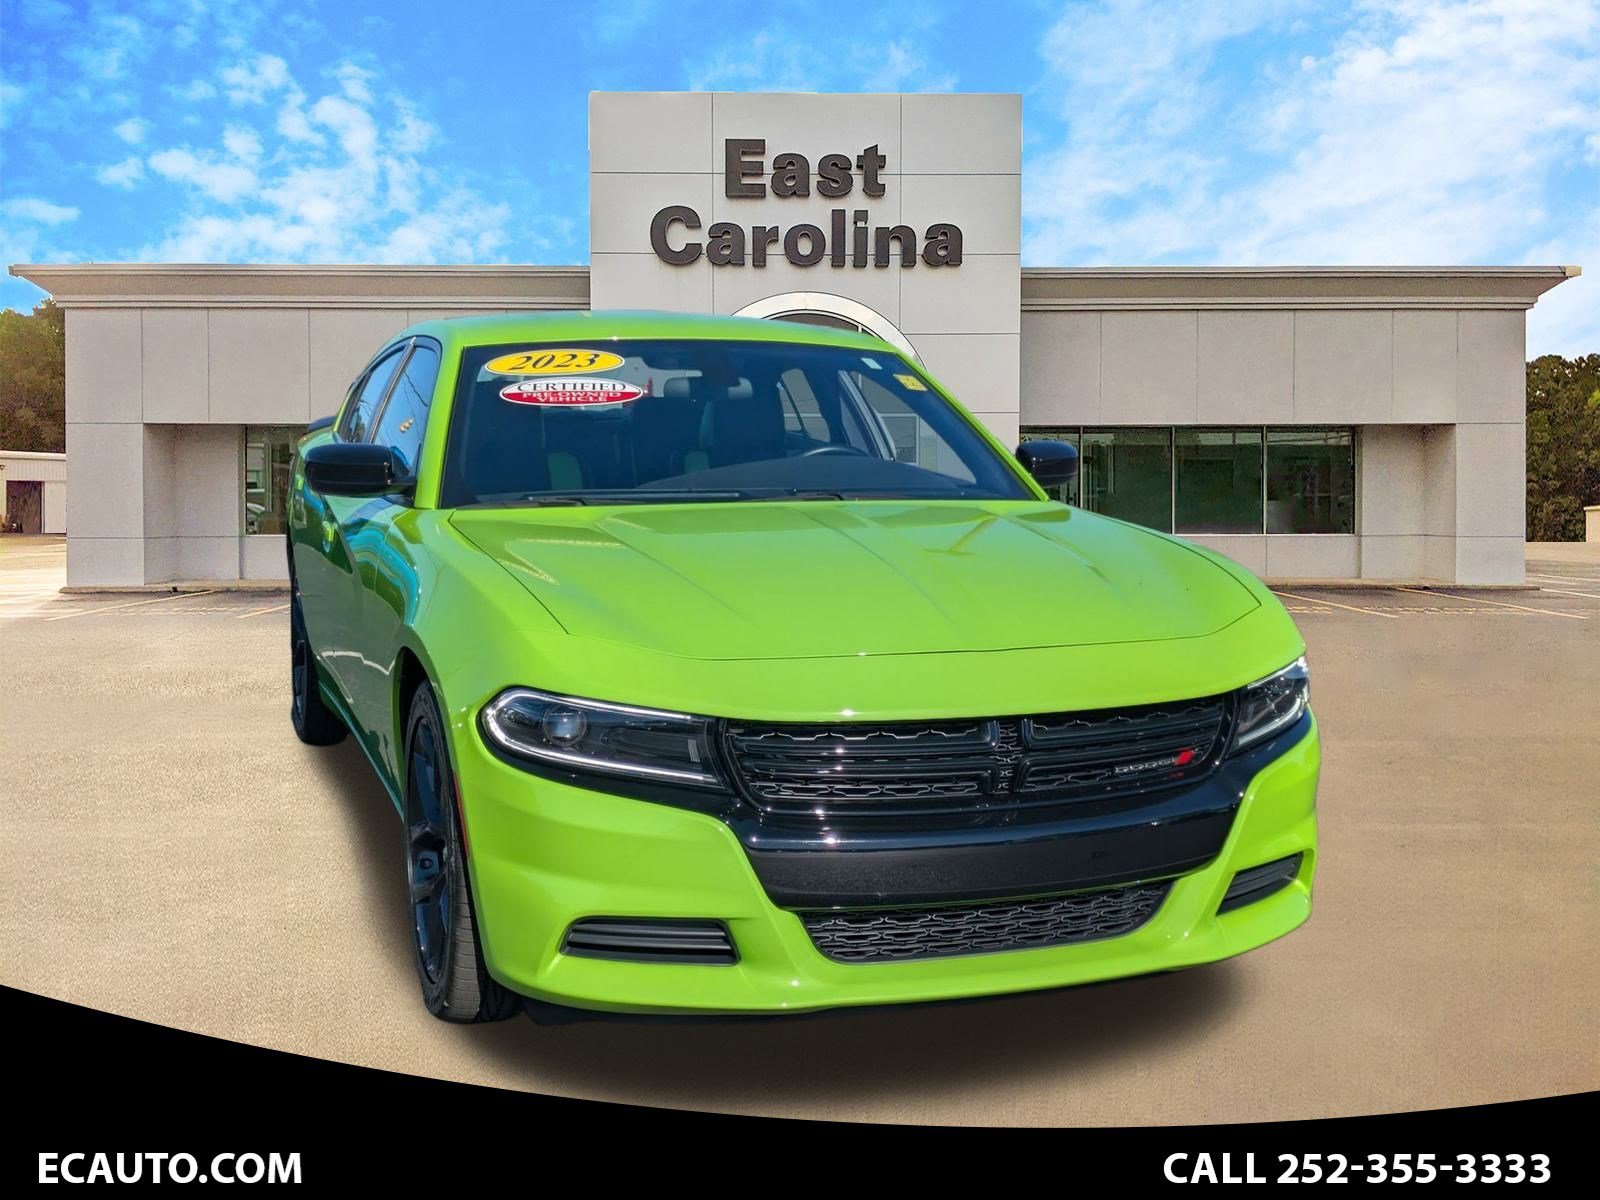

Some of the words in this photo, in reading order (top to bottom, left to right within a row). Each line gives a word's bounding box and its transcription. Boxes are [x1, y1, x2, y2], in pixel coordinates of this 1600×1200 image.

[725, 139, 886, 200] East
[650, 206, 963, 269] Carolina
[509, 353, 600, 370] 2023
[517, 383, 626, 392] CERTIFIED
